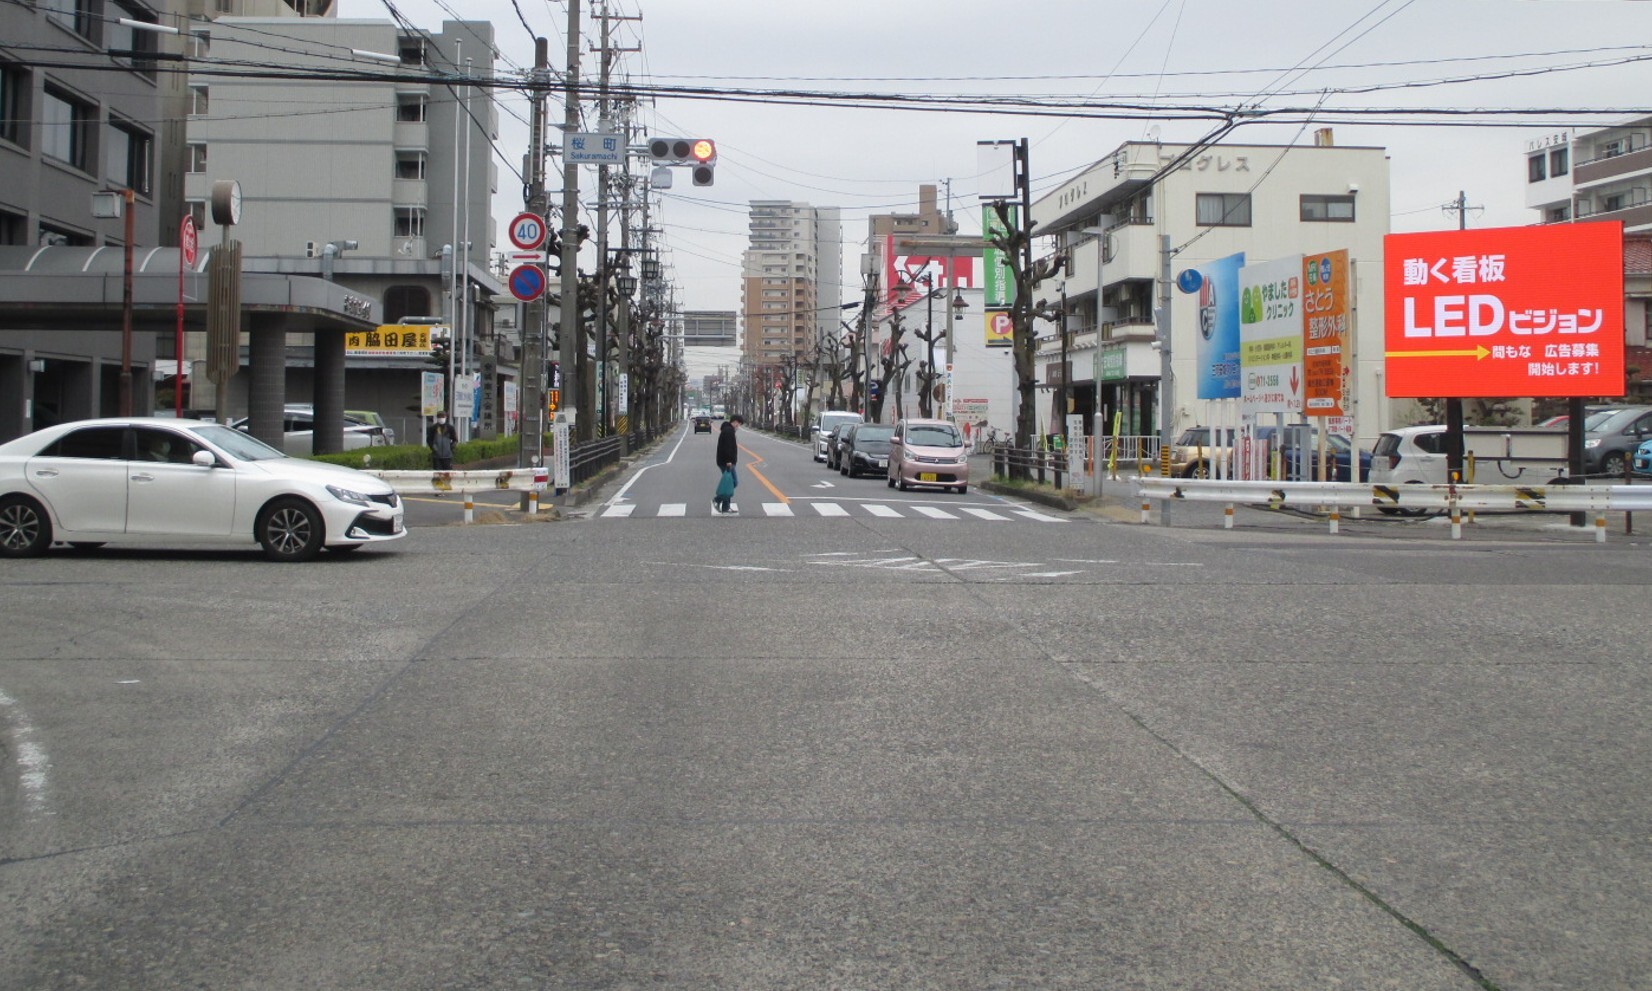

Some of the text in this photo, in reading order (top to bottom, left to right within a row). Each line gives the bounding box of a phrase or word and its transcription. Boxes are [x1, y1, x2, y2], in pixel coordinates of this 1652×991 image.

[570, 152, 618, 160] Sakuramachi
[517, 223, 538, 240] 40
[1403, 254, 1506, 285] 動く看板
[1262, 280, 1288, 303] やました
[1305, 287, 1333, 313] さとう
[1266, 301, 1294, 321] クリニック
[1404, 294, 1603, 337] LED ビジョン
[996, 315, 1009, 334] P
[1492, 343, 1599, 359] 間もな 広告募集
[1528, 362, 1599, 376] 開始します!
